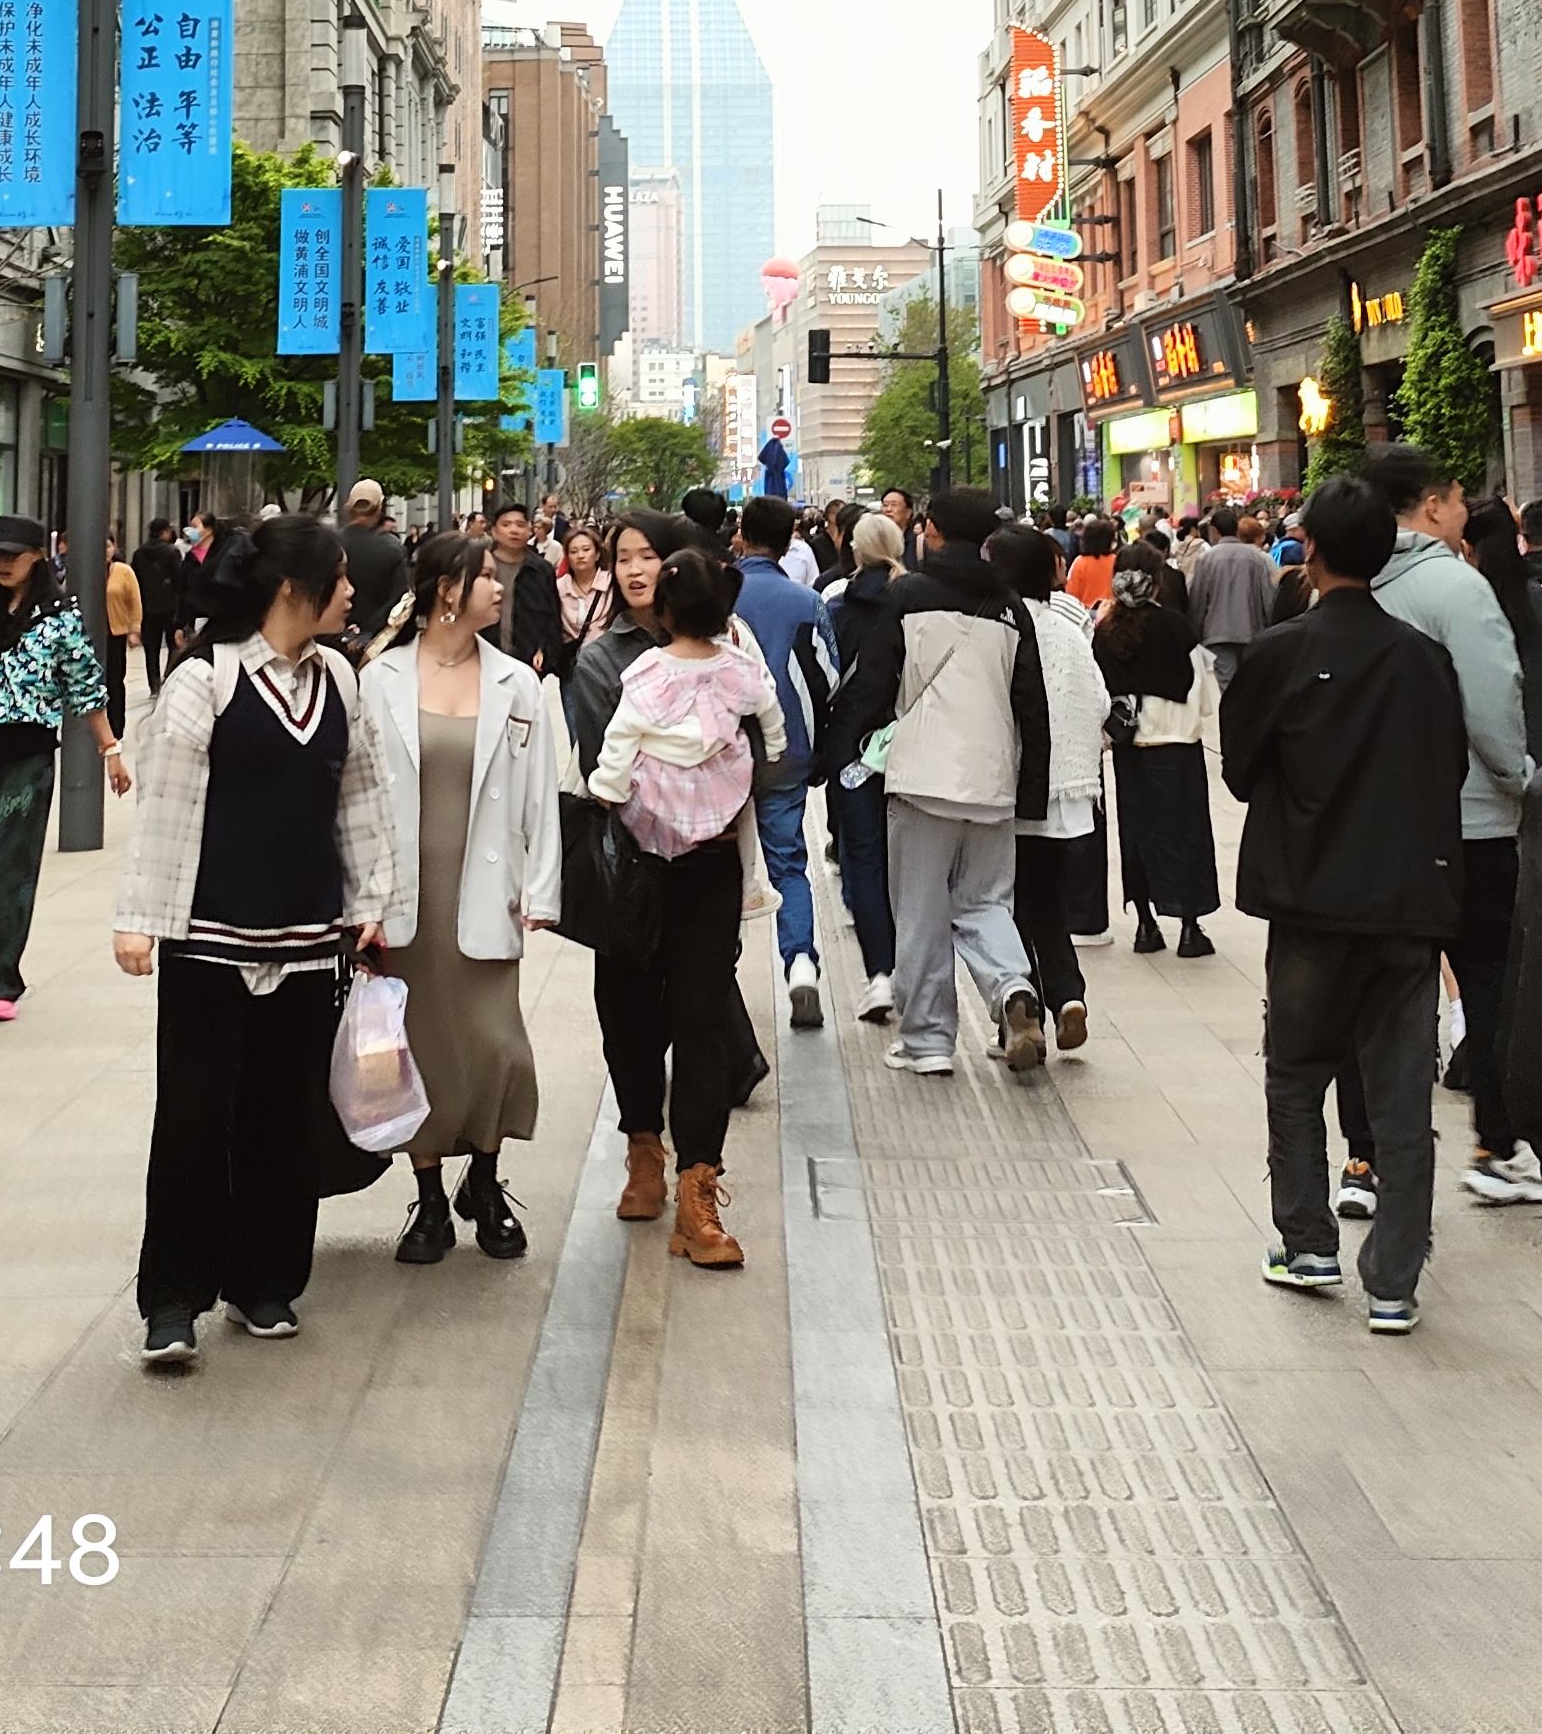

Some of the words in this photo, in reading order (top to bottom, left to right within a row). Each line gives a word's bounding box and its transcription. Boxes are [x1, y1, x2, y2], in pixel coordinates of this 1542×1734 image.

[134, 13, 163, 71] 公正
[174, 12, 203, 70] 自由
[23, 2, 44, 183] 净化未成年人成长环境
[132, 91, 164, 155] 法治
[172, 89, 203, 155] 平等
[629, 190, 659, 204] LAZA
[372, 236, 391, 270] 诚信
[394, 236, 411, 271] 爱国
[603, 185, 625, 284] HUAWEI
[293, 229, 310, 329] 做黄浦文明人
[313, 229, 330, 329] 创全国文明城
[373, 279, 391, 315] 友善
[394, 280, 412, 313] 敬业
[827, 265, 889, 290] 雅戈尔
[459, 318, 472, 341] 文明
[474, 317, 487, 341] 富强
